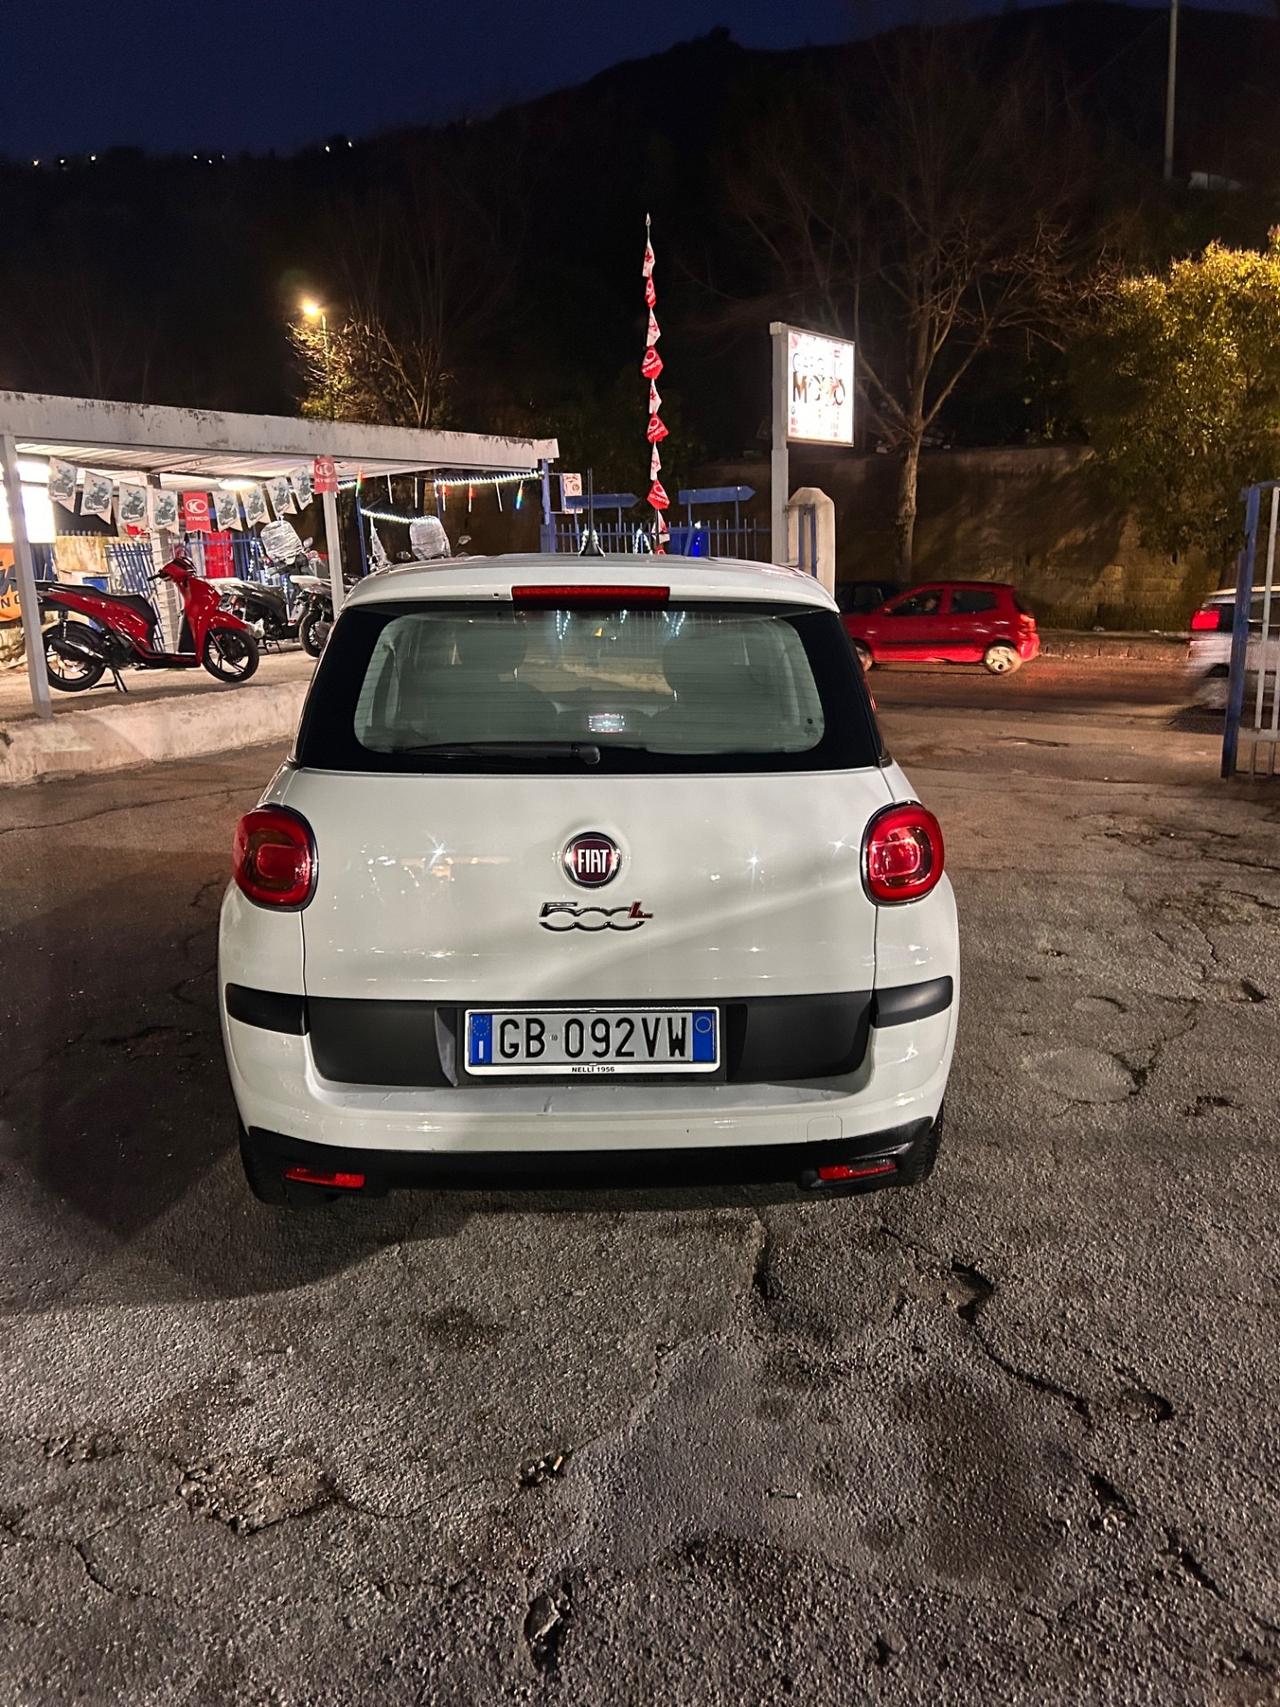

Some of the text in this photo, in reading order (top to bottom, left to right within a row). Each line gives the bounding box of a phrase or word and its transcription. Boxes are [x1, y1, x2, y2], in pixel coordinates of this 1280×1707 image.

[577, 849, 609, 873] FIAT
[539, 901, 654, 932] 500L
[500, 1018, 546, 1059] GB
[564, 1017, 687, 1058] 092VW
